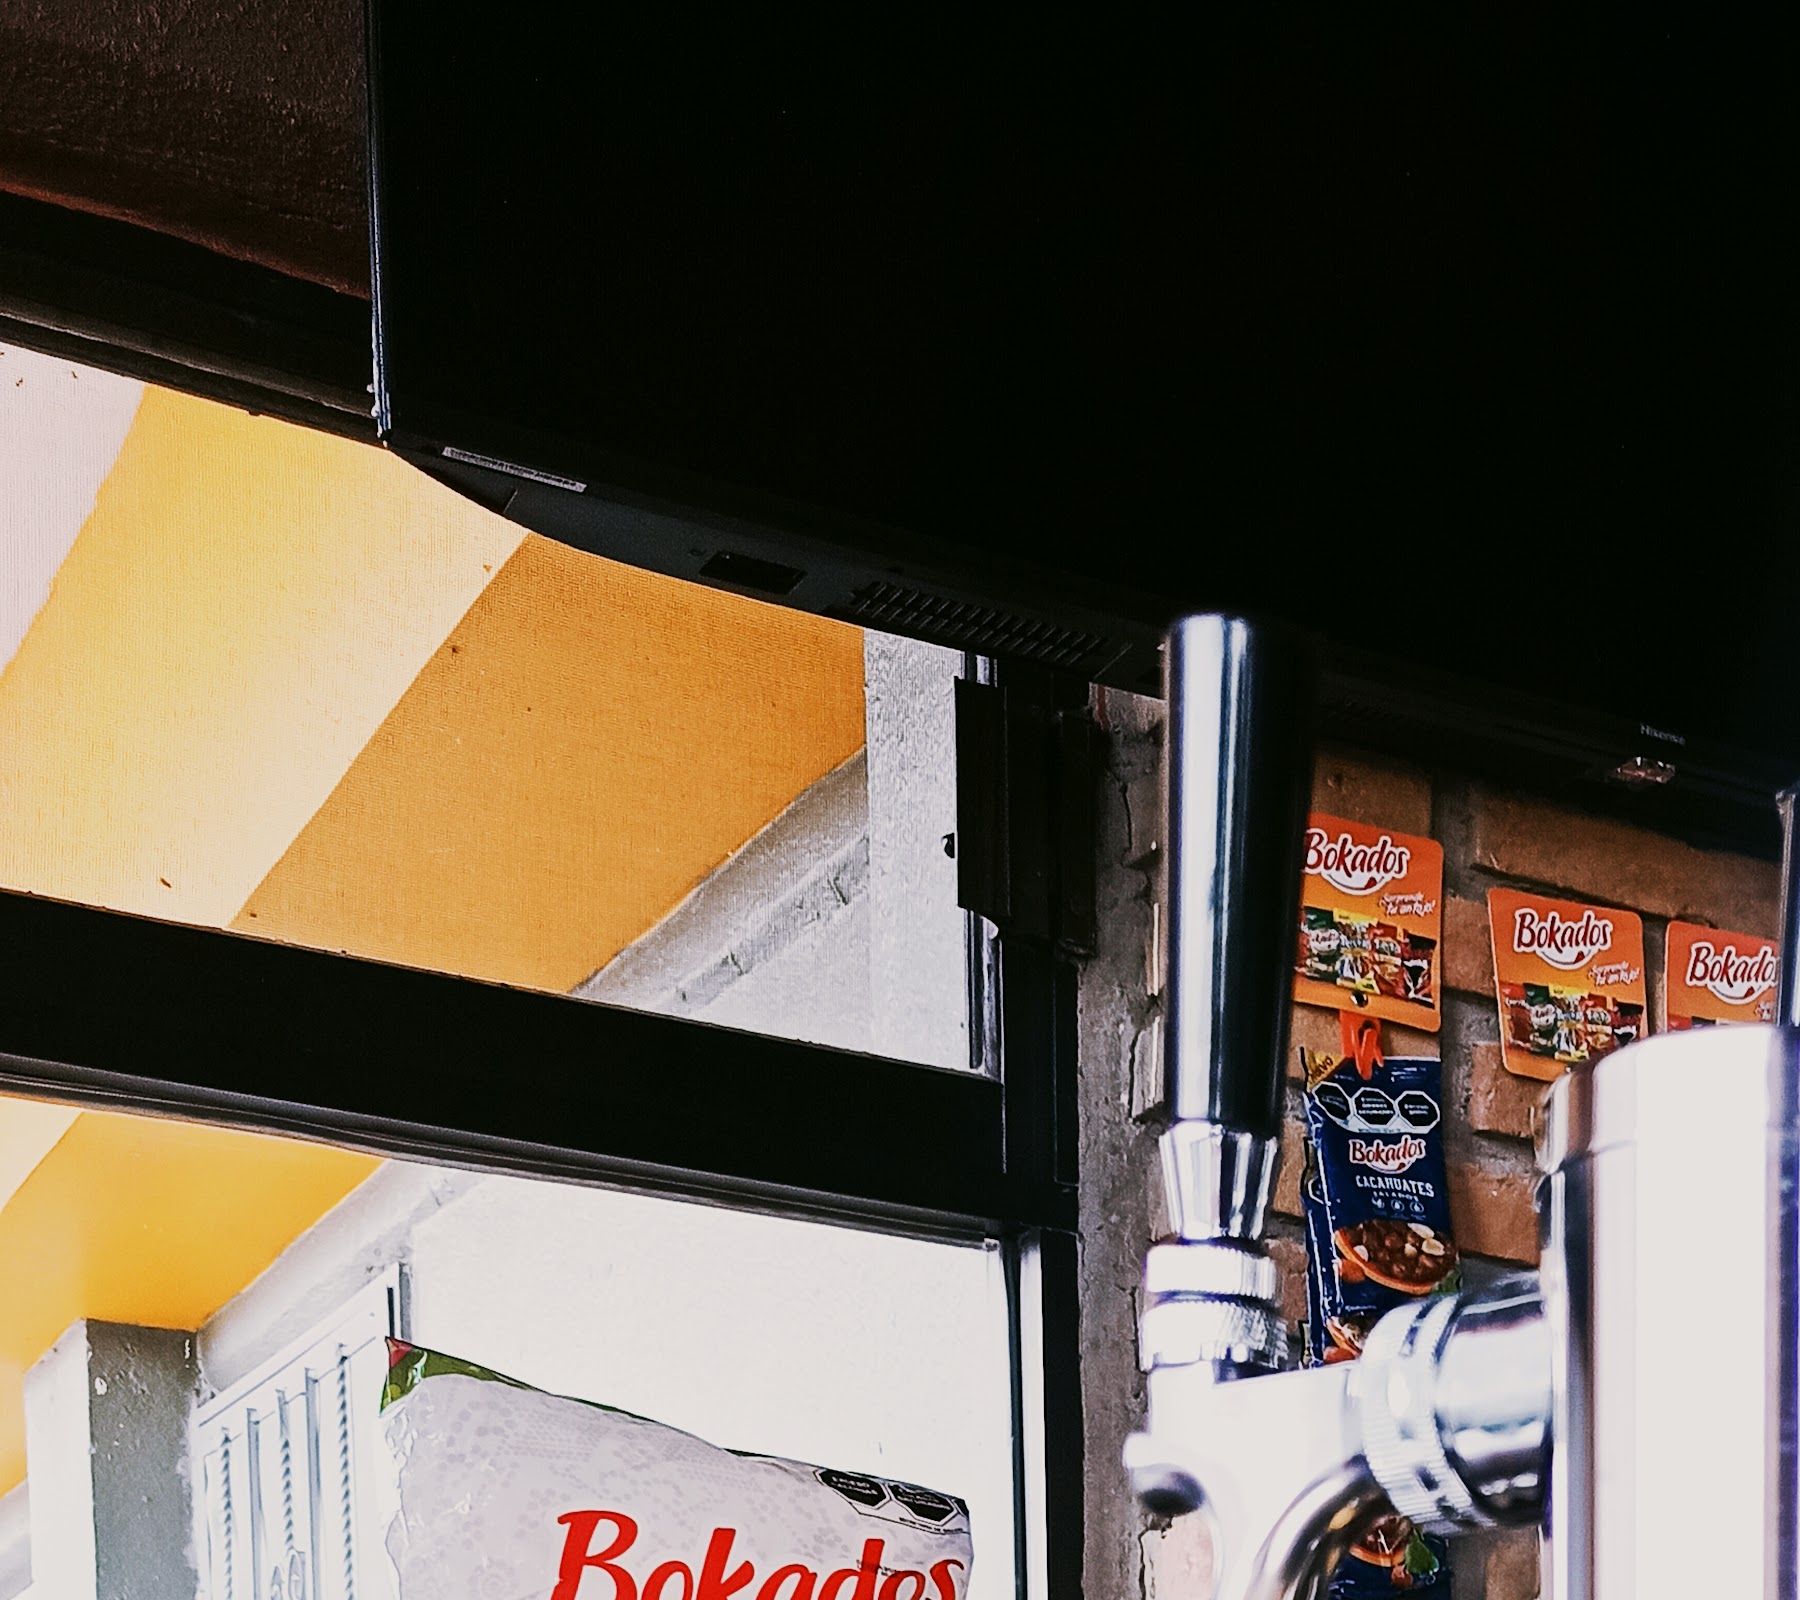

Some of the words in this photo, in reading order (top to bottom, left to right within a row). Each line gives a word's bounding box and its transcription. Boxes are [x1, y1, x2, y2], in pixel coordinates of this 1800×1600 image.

[1304, 829, 1409, 879] Bokados
[1515, 909, 1613, 954] Bokados
[1687, 942, 1778, 989] Bokado
[1350, 1135, 1426, 1168] Bokados
[1356, 1175, 1435, 1198] CACAHUATES
